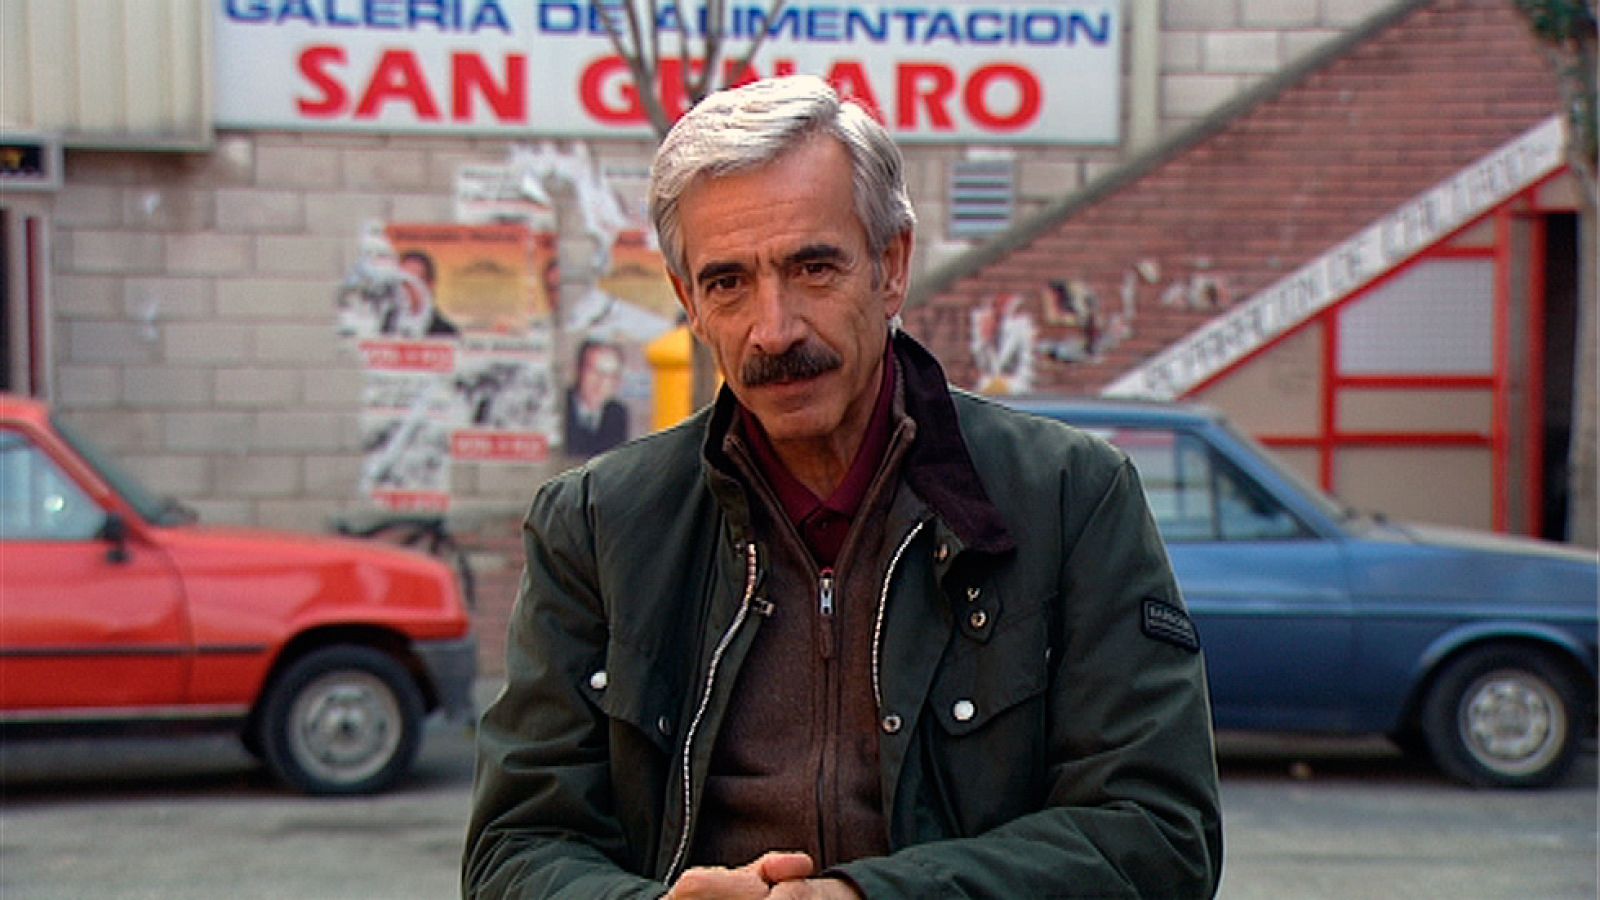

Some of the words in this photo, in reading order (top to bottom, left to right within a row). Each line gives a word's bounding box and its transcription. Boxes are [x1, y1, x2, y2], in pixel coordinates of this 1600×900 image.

[223, 0, 511, 34] GALERIA
[538, 0, 626, 37] DE
[648, 3, 1111, 45] ALIMENTACION
[296, 44, 528, 123] SAN
